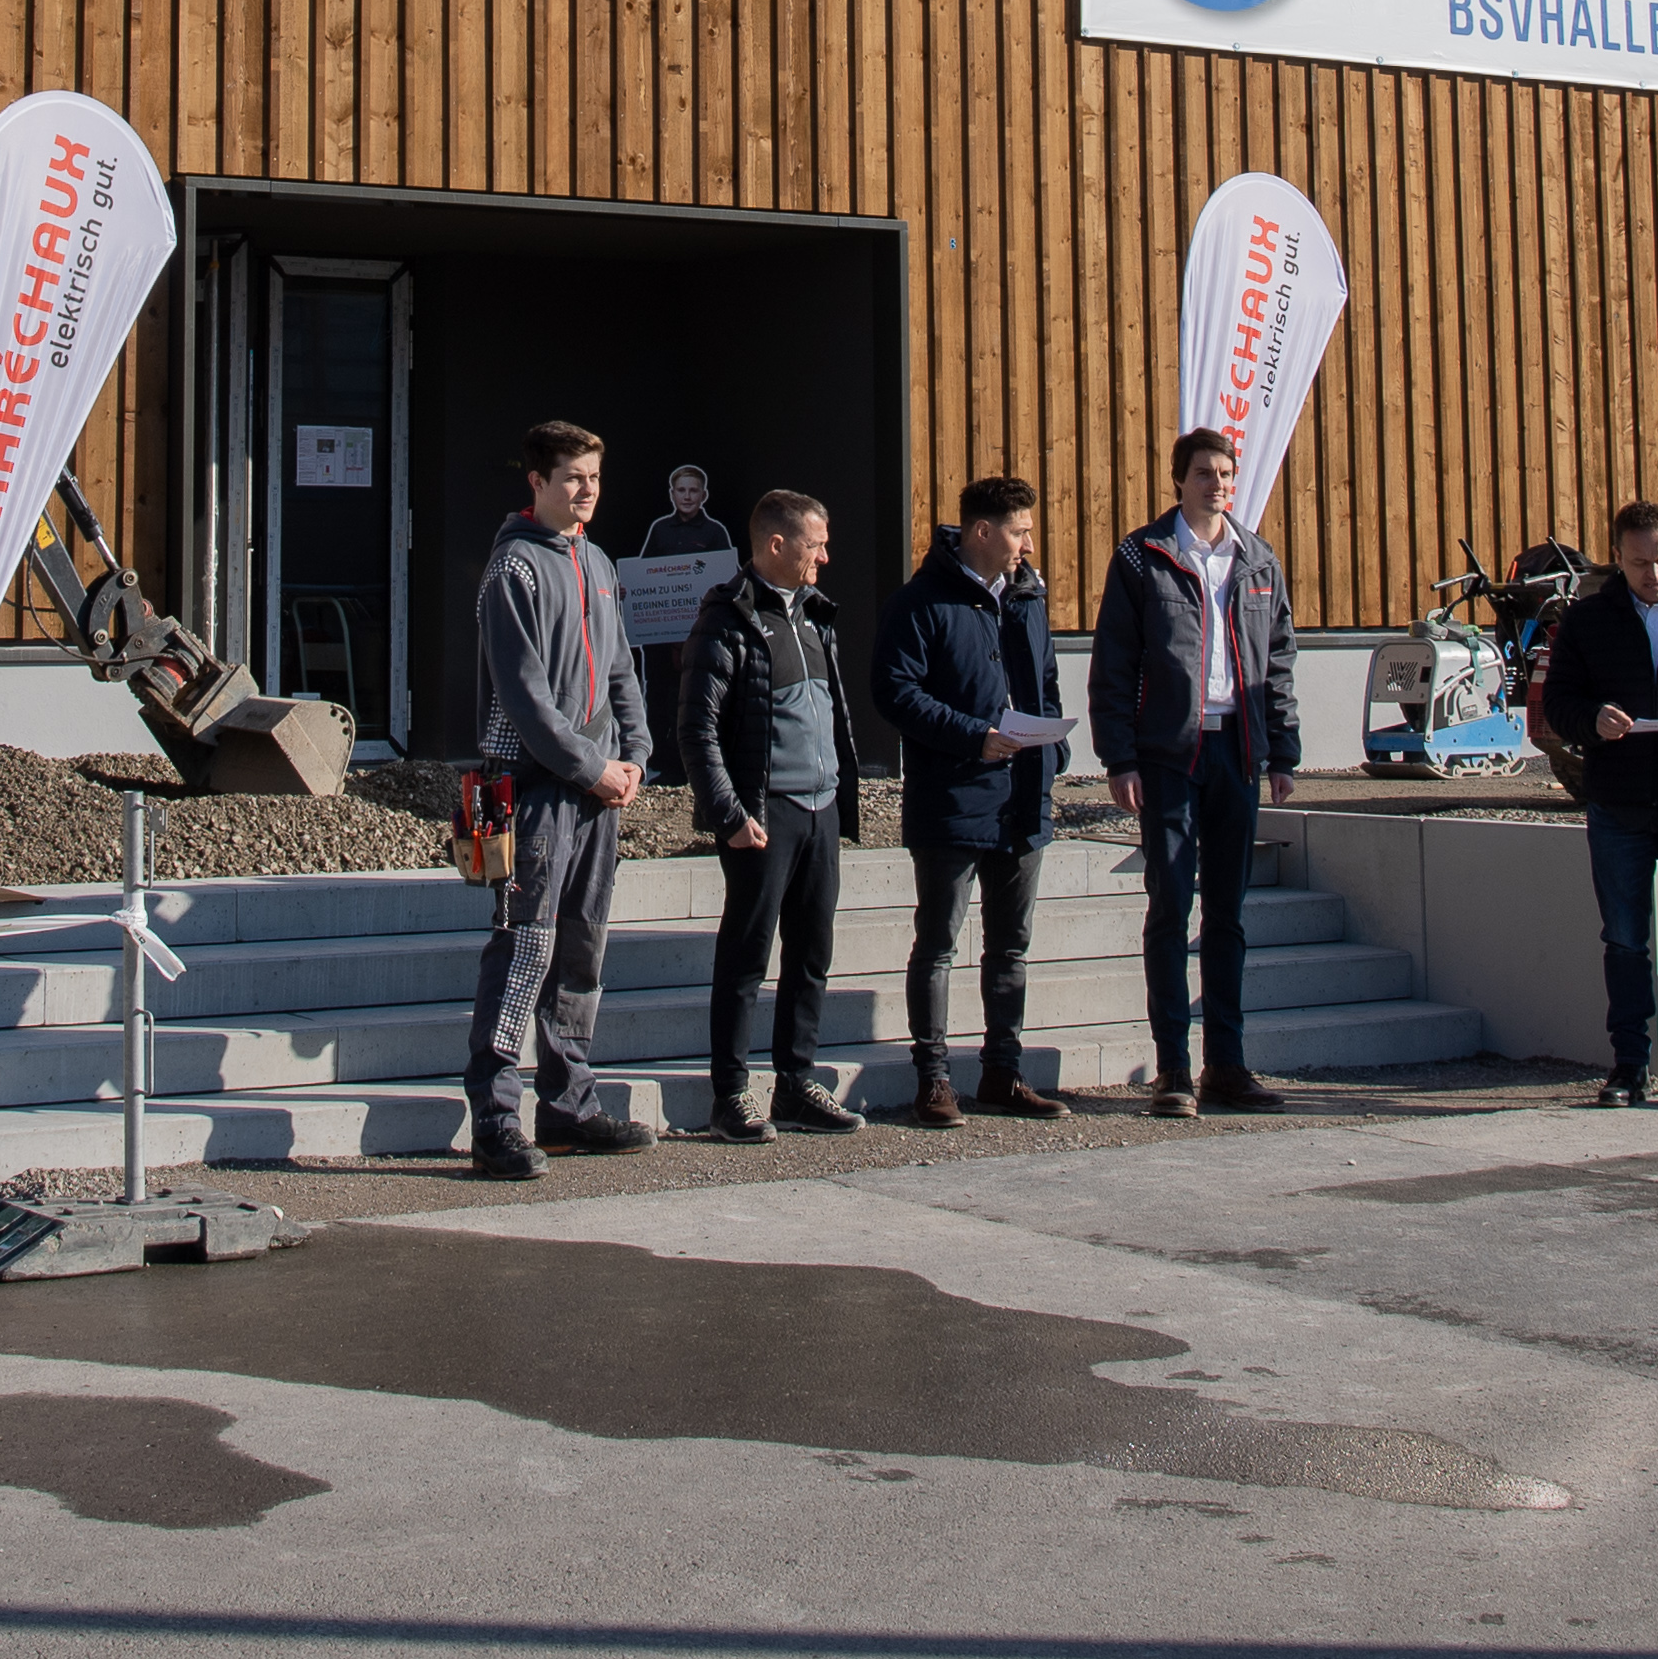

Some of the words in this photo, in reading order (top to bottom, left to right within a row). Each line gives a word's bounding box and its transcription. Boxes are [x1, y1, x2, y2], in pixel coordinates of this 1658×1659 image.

[50, 212, 103, 370] elektrisch
[92, 156, 118, 210] gut.
[1260, 282, 1293, 408] elektrisch
[1284, 232, 1301, 276] gut.
[631, 587, 657, 597] KOMM
[658, 586, 669, 595] ZU
[671, 583, 693, 594] UNS!
[632, 600, 670, 611] BEGINNE
[671, 597, 698, 608] DEINE
